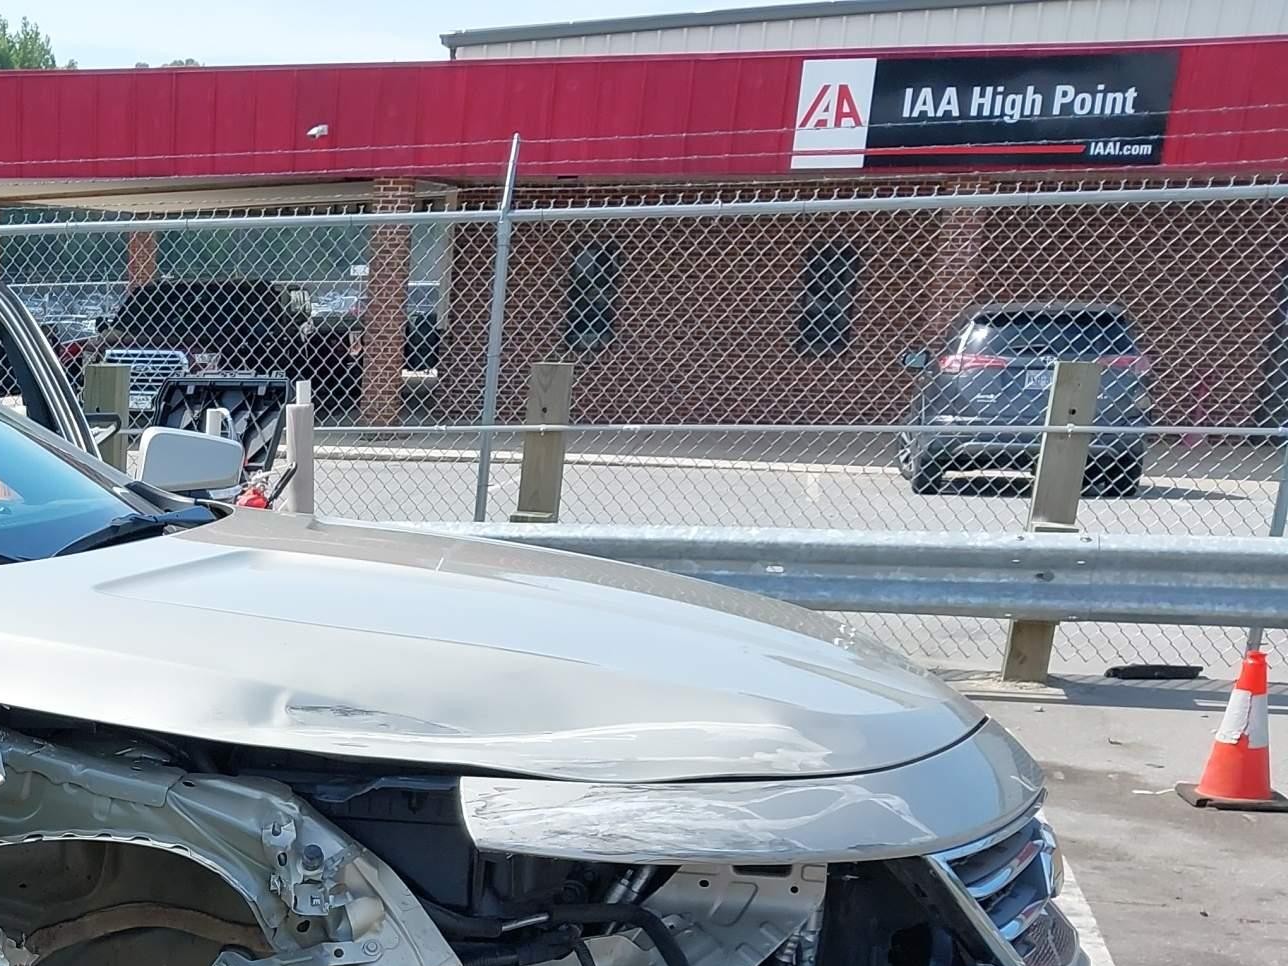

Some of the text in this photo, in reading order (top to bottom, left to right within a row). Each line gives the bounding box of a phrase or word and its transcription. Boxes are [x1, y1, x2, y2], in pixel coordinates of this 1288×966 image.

[902, 84, 1138, 124] IAA High Point
[1089, 142, 1152, 156] IAAI.com
